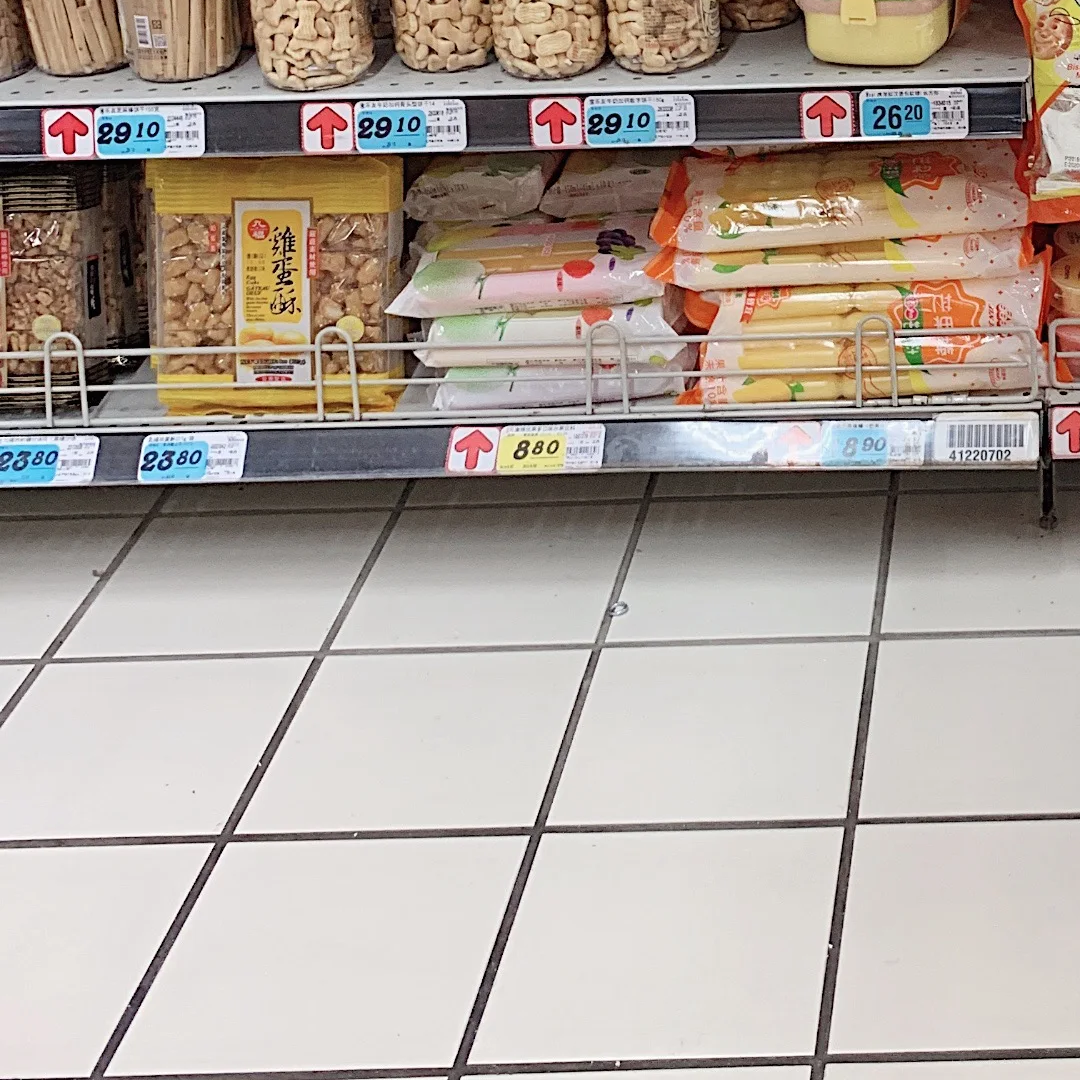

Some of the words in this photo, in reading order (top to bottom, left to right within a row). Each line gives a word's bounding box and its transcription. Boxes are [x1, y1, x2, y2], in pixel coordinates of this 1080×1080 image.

[587, 112, 651, 136] 2910
[873, 103, 923, 130] 2620
[97, 120, 160, 146] 2910
[358, 116, 421, 141] 2910
[513, 439, 560, 461] 880
[841, 436, 886, 458] 890
[949, 448, 1011, 463] 41220702
[140, 449, 202, 472] 2380
